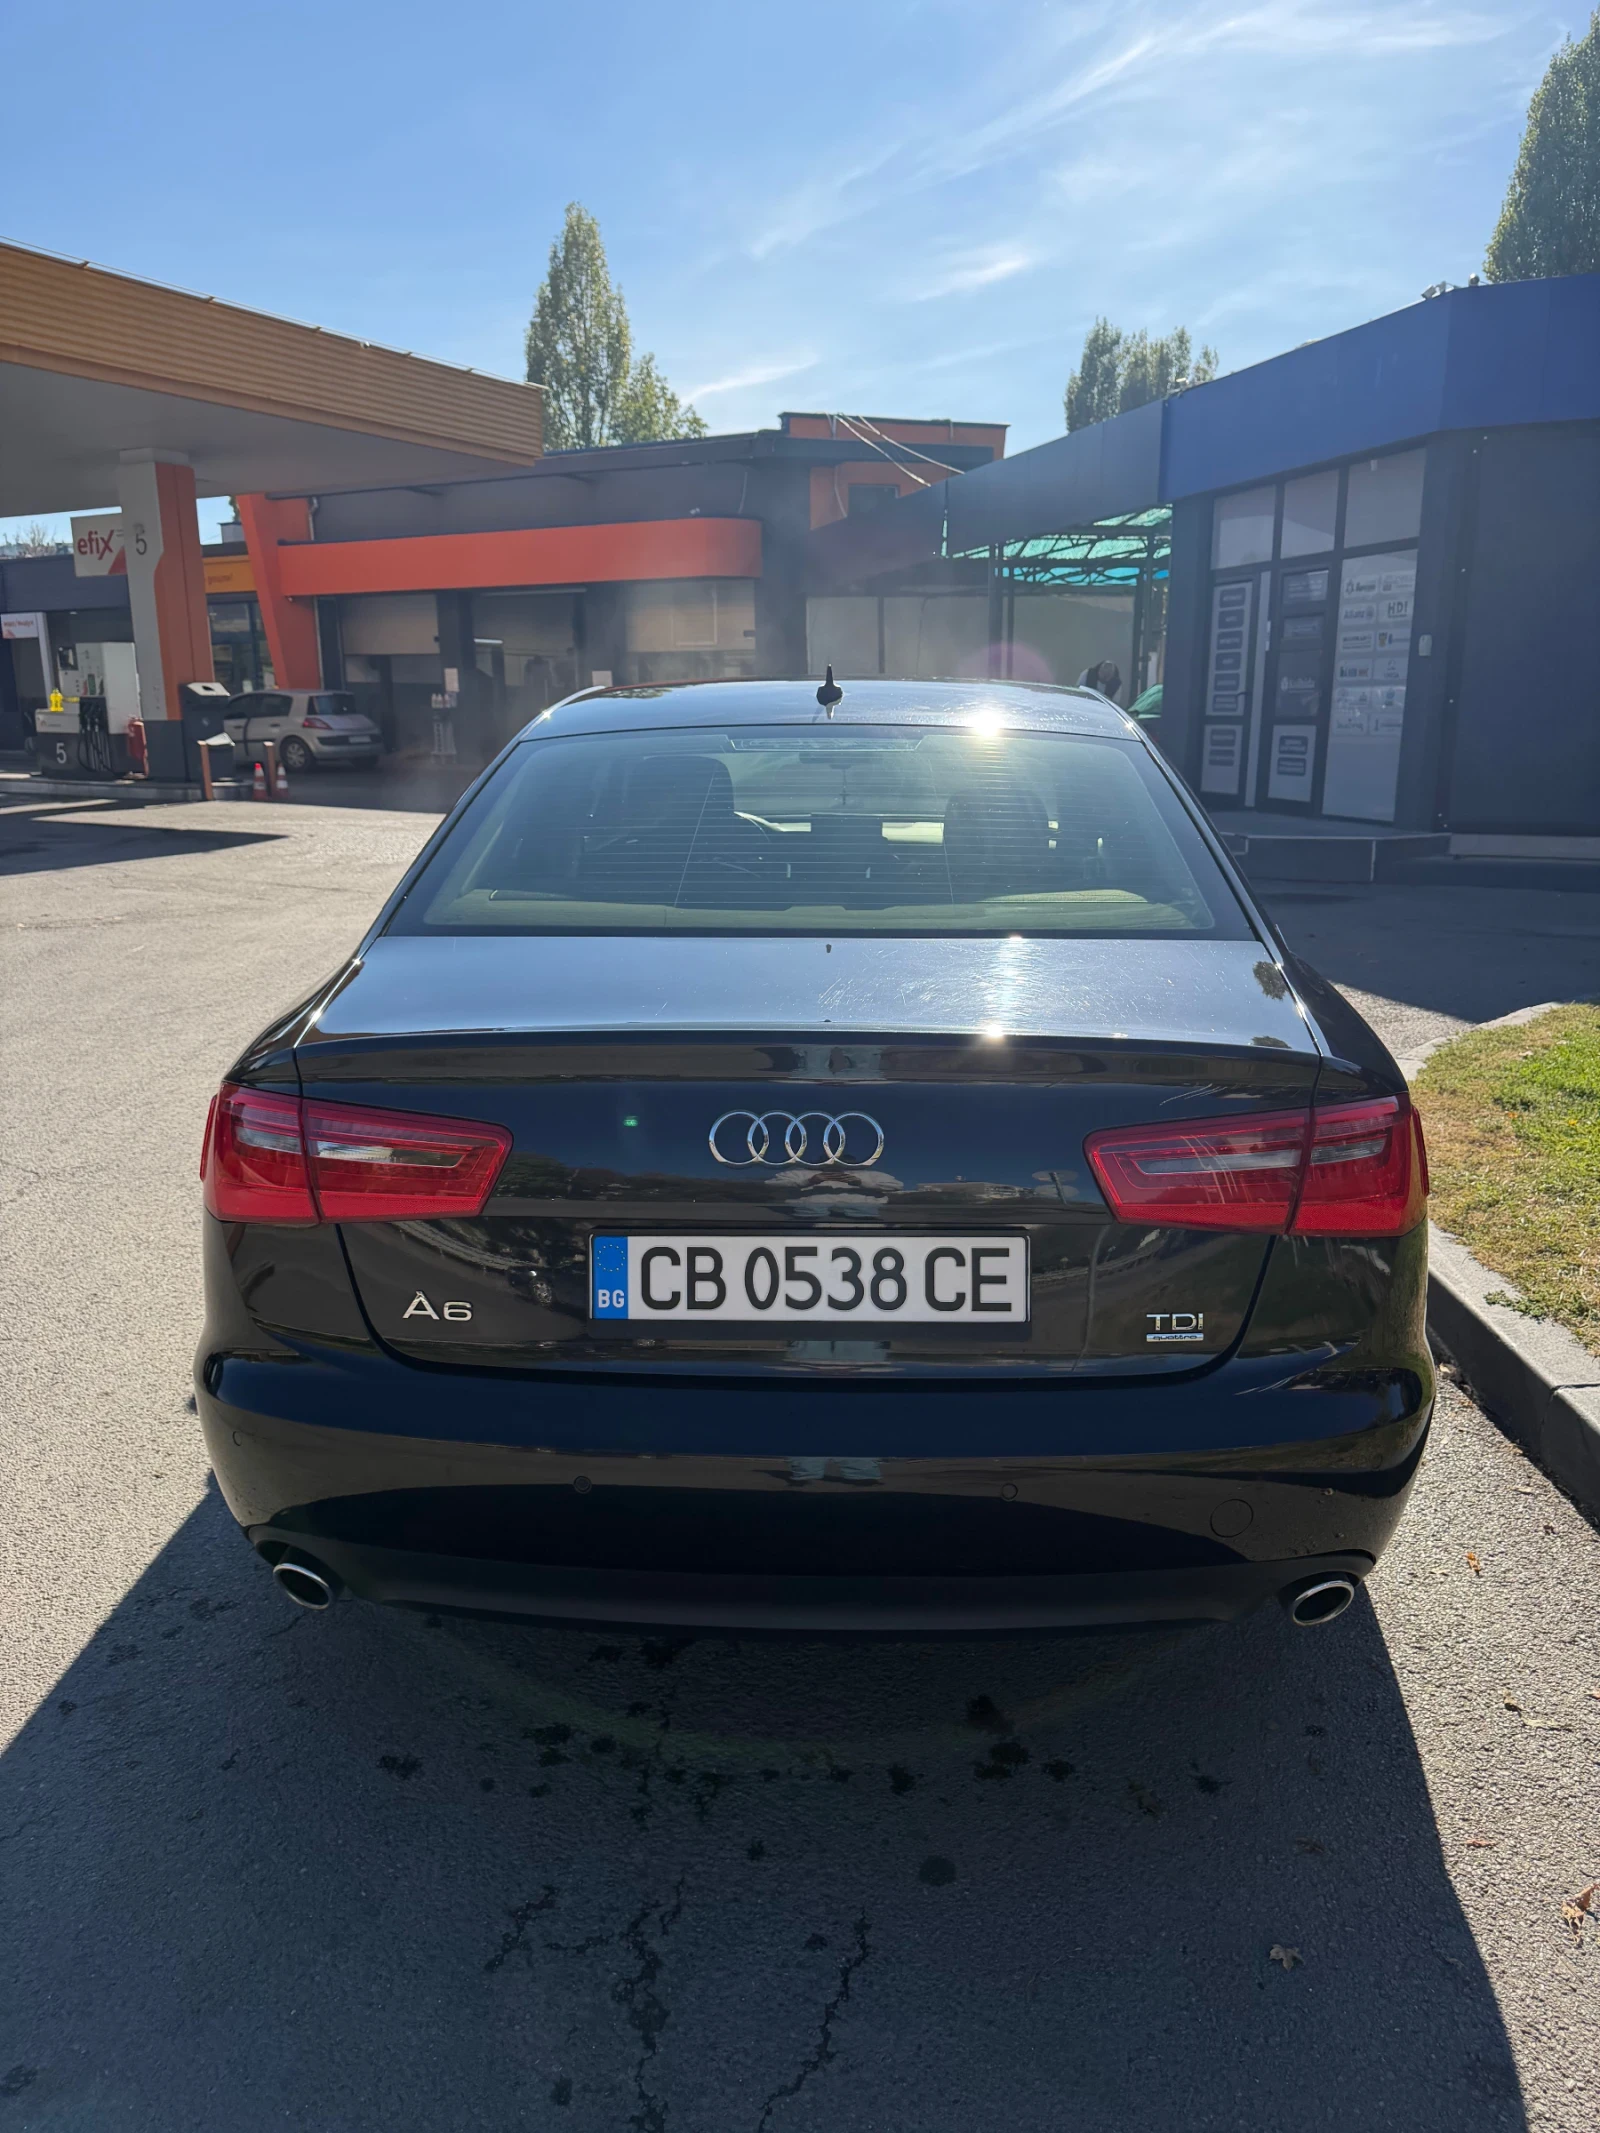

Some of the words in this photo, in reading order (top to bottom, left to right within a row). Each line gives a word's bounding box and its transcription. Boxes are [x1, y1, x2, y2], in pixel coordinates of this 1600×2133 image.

[77, 529, 115, 561] efix
[135, 530, 147, 555] 5
[1388, 600, 1408, 614] HDI
[56, 742, 67, 764] 5
[744, 1246, 907, 1311] 0538
[402, 1290, 472, 1321] A6
[597, 1289, 625, 1308] BG
[1146, 1313, 1204, 1330] TDI
